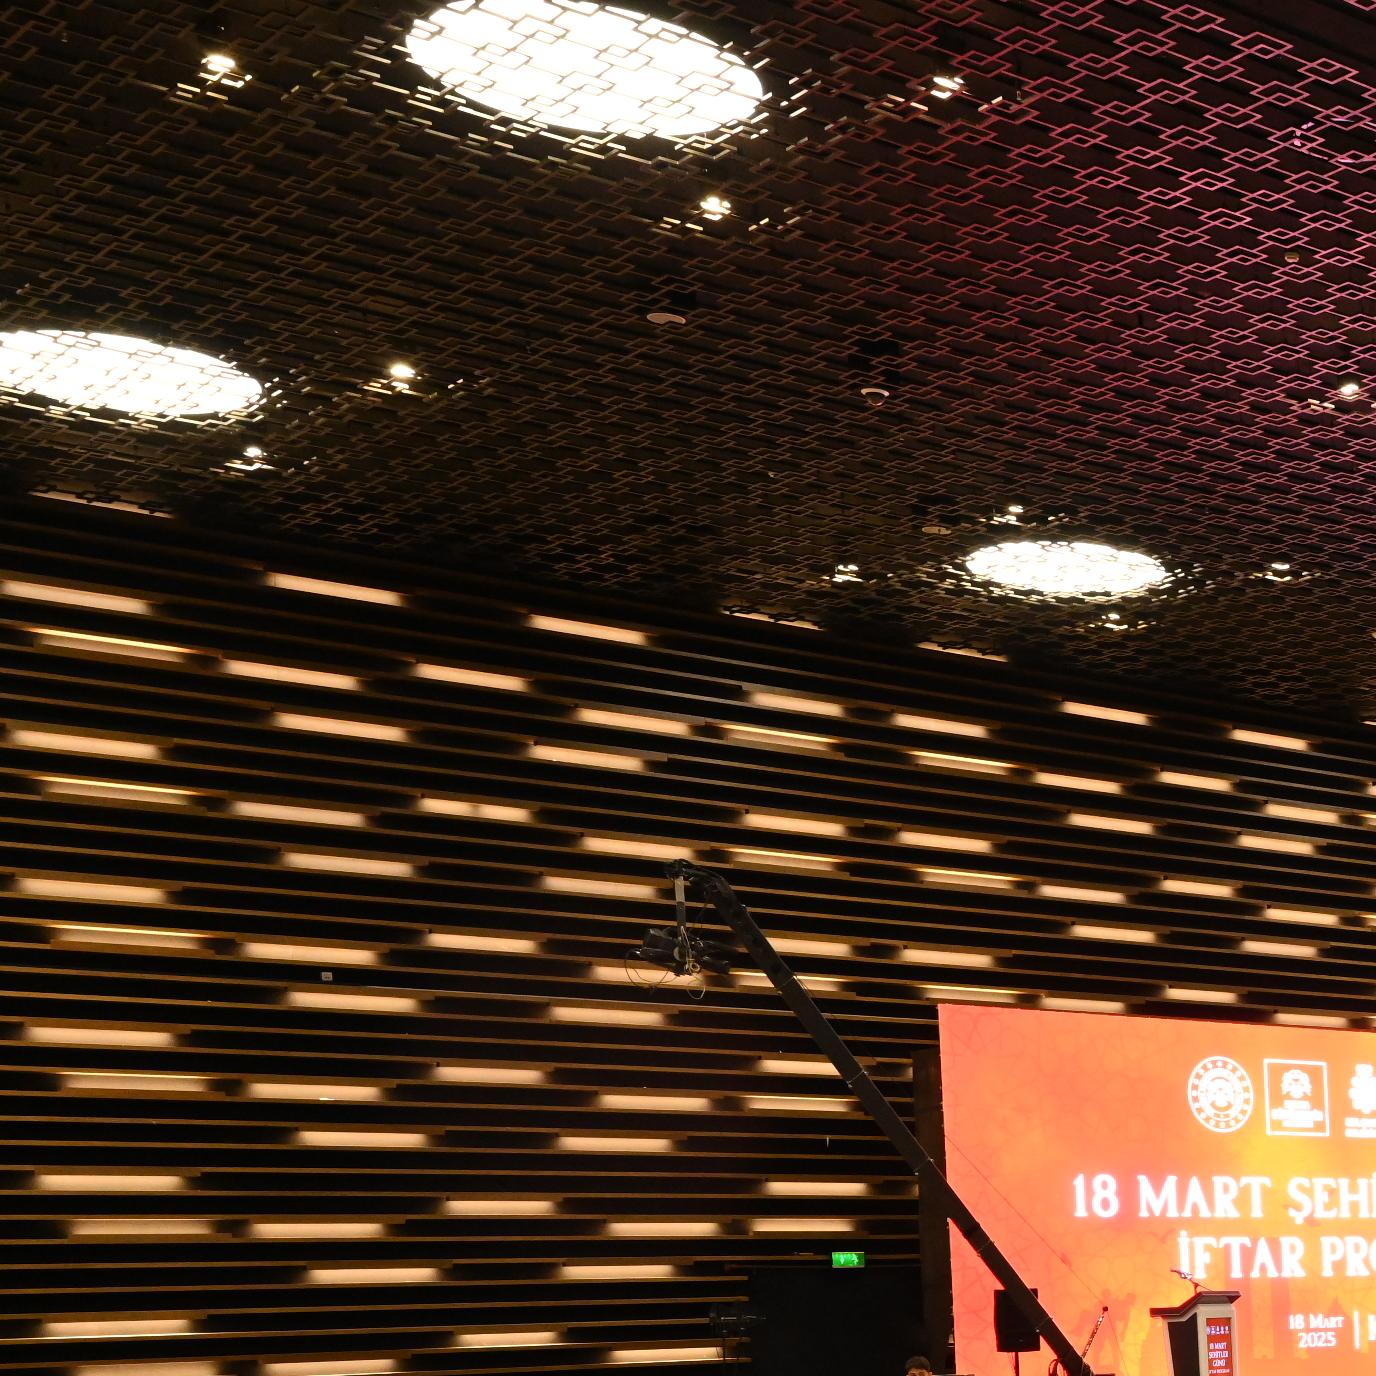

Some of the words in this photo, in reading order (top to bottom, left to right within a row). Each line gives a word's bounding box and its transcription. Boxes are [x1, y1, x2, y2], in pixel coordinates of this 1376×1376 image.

[1073, 1173, 1120, 1218] 18
[1137, 1174, 1272, 1218] MART
[1177, 1230, 1306, 1279] İFTAR
[1288, 1313, 1305, 1330] 18
[1298, 1331, 1337, 1348] 2025
